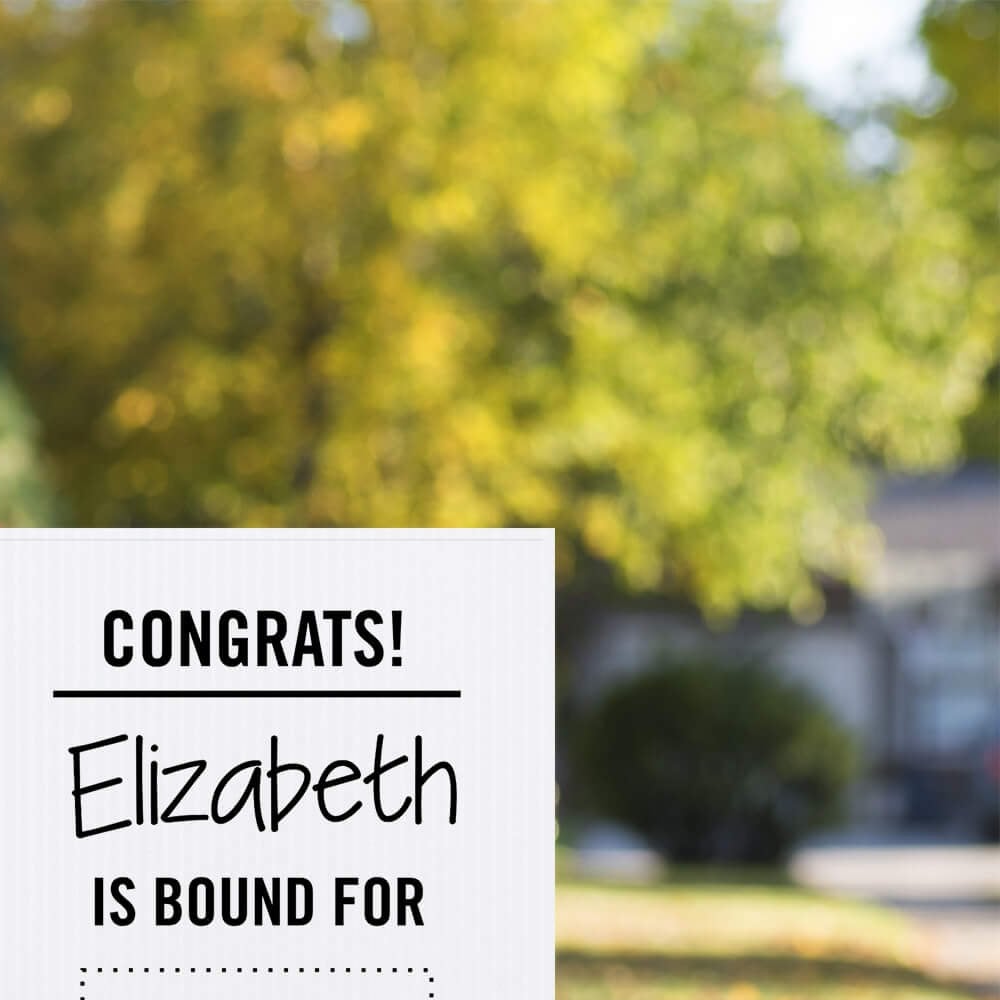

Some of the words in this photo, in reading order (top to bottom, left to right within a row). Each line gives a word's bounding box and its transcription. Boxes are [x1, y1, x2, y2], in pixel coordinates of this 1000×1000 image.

[103, 609, 403, 668] CONGRATS!
[67, 733, 458, 839] Elizabeth
[94, 876, 136, 927] IS
[155, 877, 314, 927] BOUND
[334, 876, 425, 927] FOR
